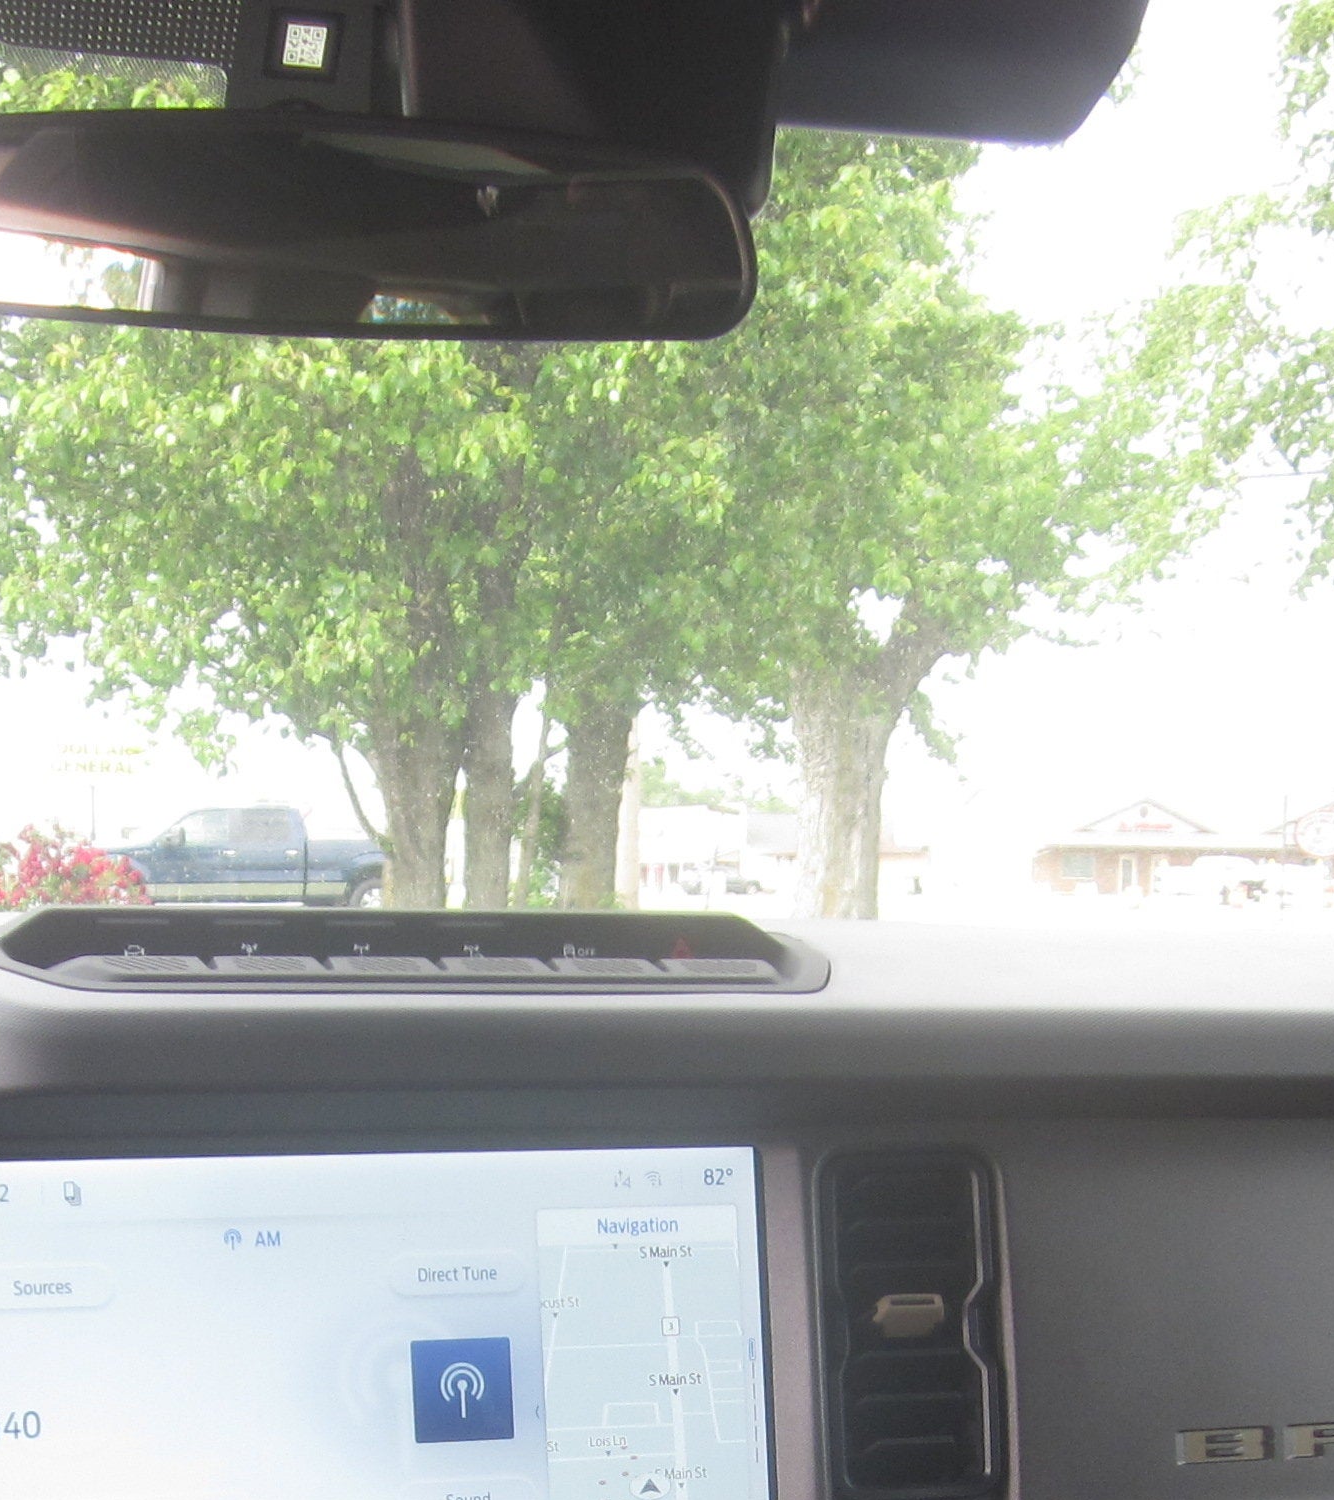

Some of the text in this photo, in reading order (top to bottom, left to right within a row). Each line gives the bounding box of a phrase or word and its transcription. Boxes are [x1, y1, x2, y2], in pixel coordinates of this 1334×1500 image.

[596, 1217, 679, 1237] Navigation
[255, 1230, 282, 1248] AM
[639, 1245, 693, 1259] S Main St
[417, 1265, 498, 1283] Direct Tune
[13, 1279, 73, 1297] Sources
[567, 1295, 580, 1309] St
[648, 1372, 702, 1387] S Main St
[665, 1466, 708, 1480] Main St
